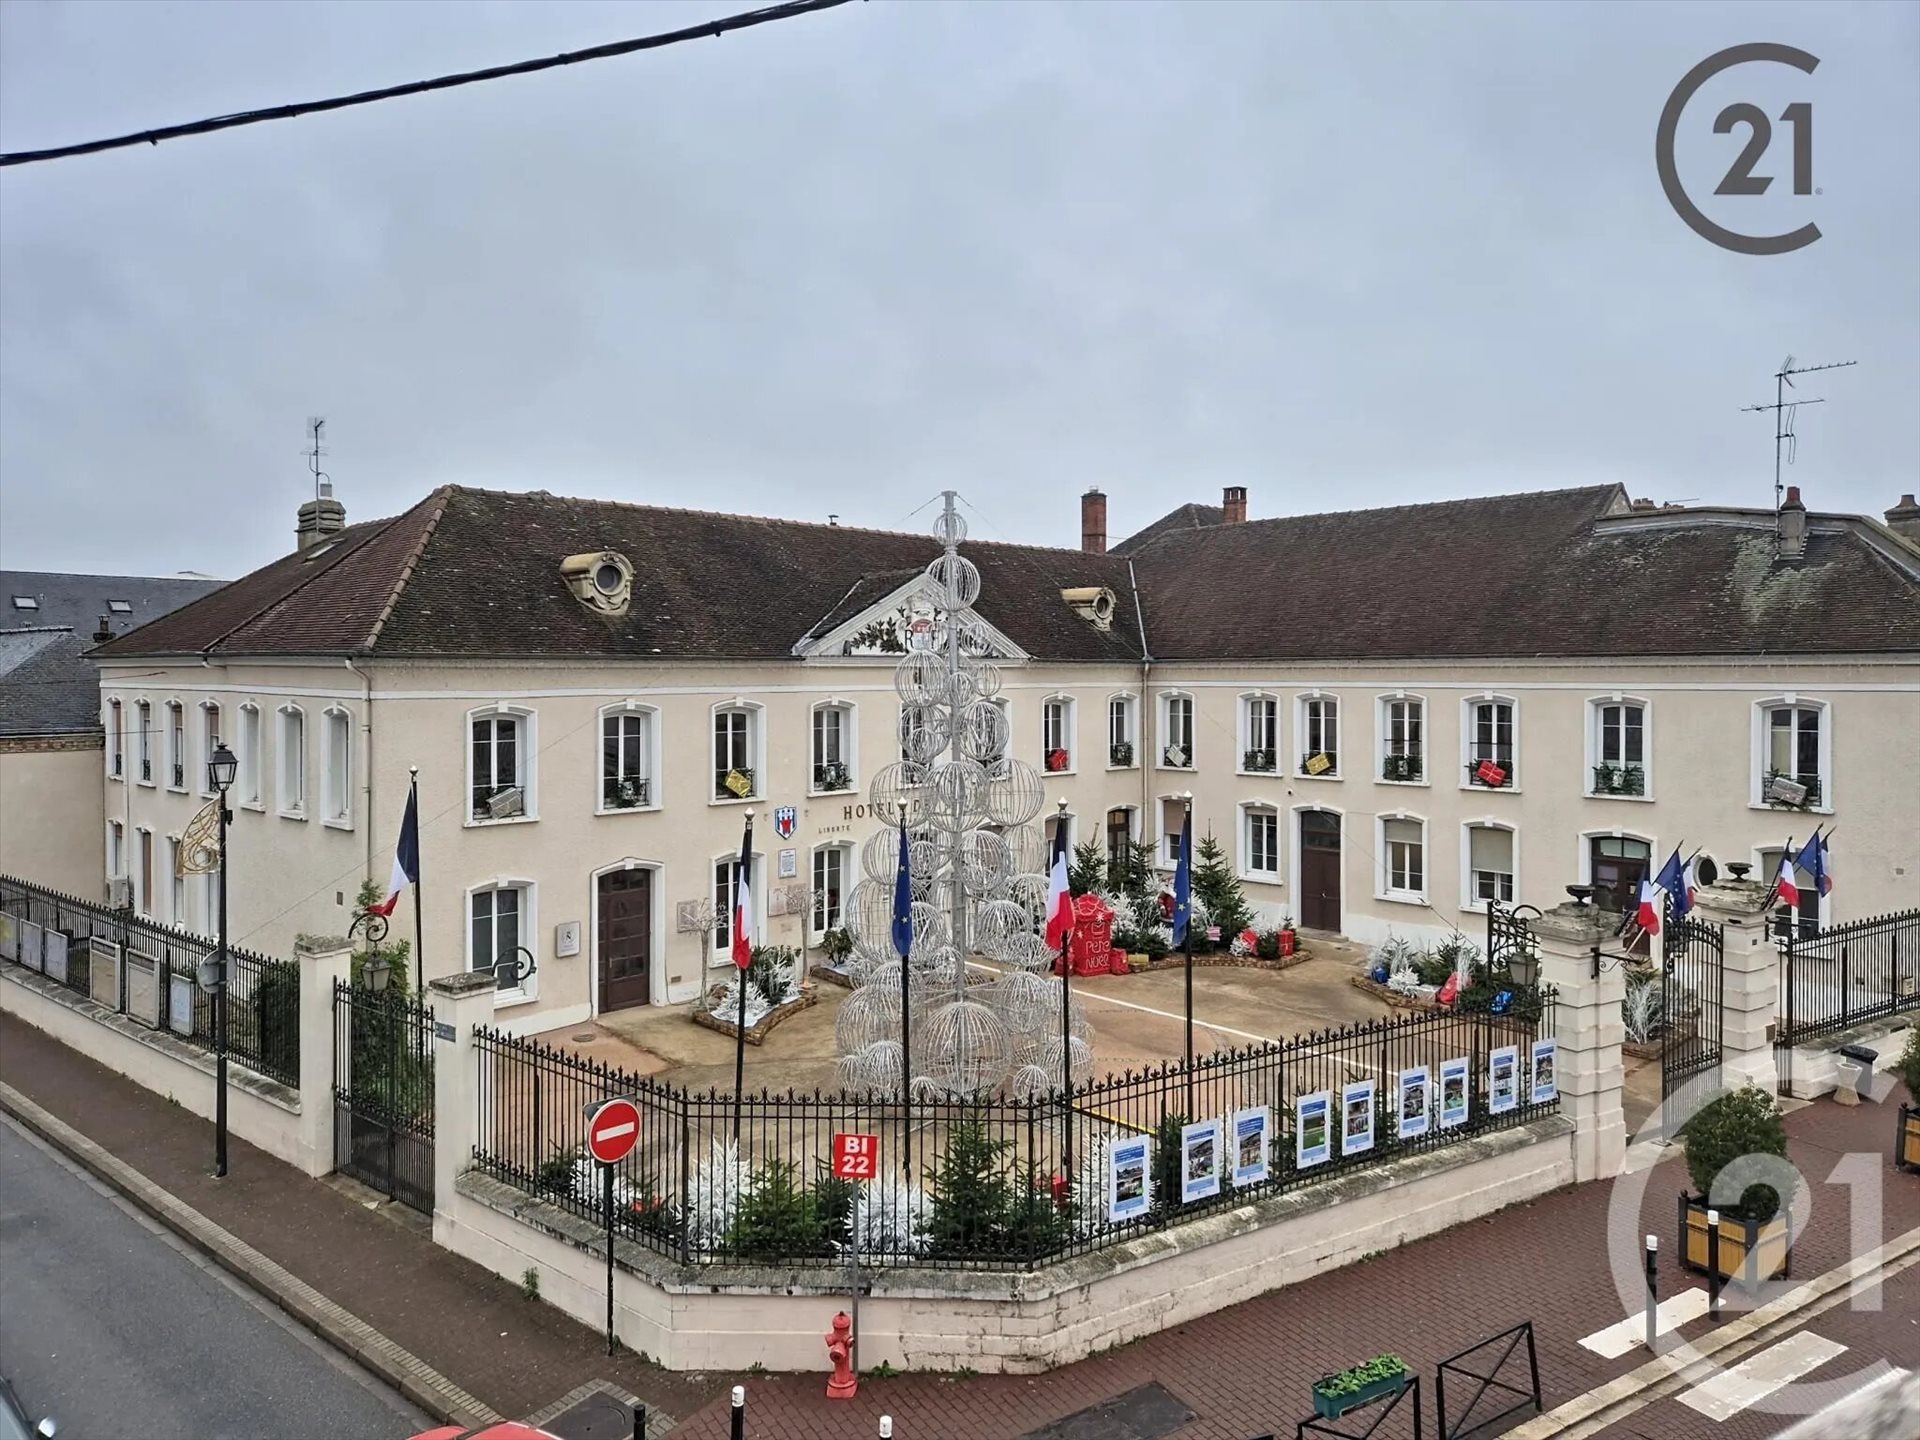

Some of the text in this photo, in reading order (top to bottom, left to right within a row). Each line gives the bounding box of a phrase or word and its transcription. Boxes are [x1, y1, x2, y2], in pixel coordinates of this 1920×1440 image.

[843, 801, 895, 820] HOTEL
[844, 1136, 868, 1155] BI
[841, 1155, 870, 1174] 22
